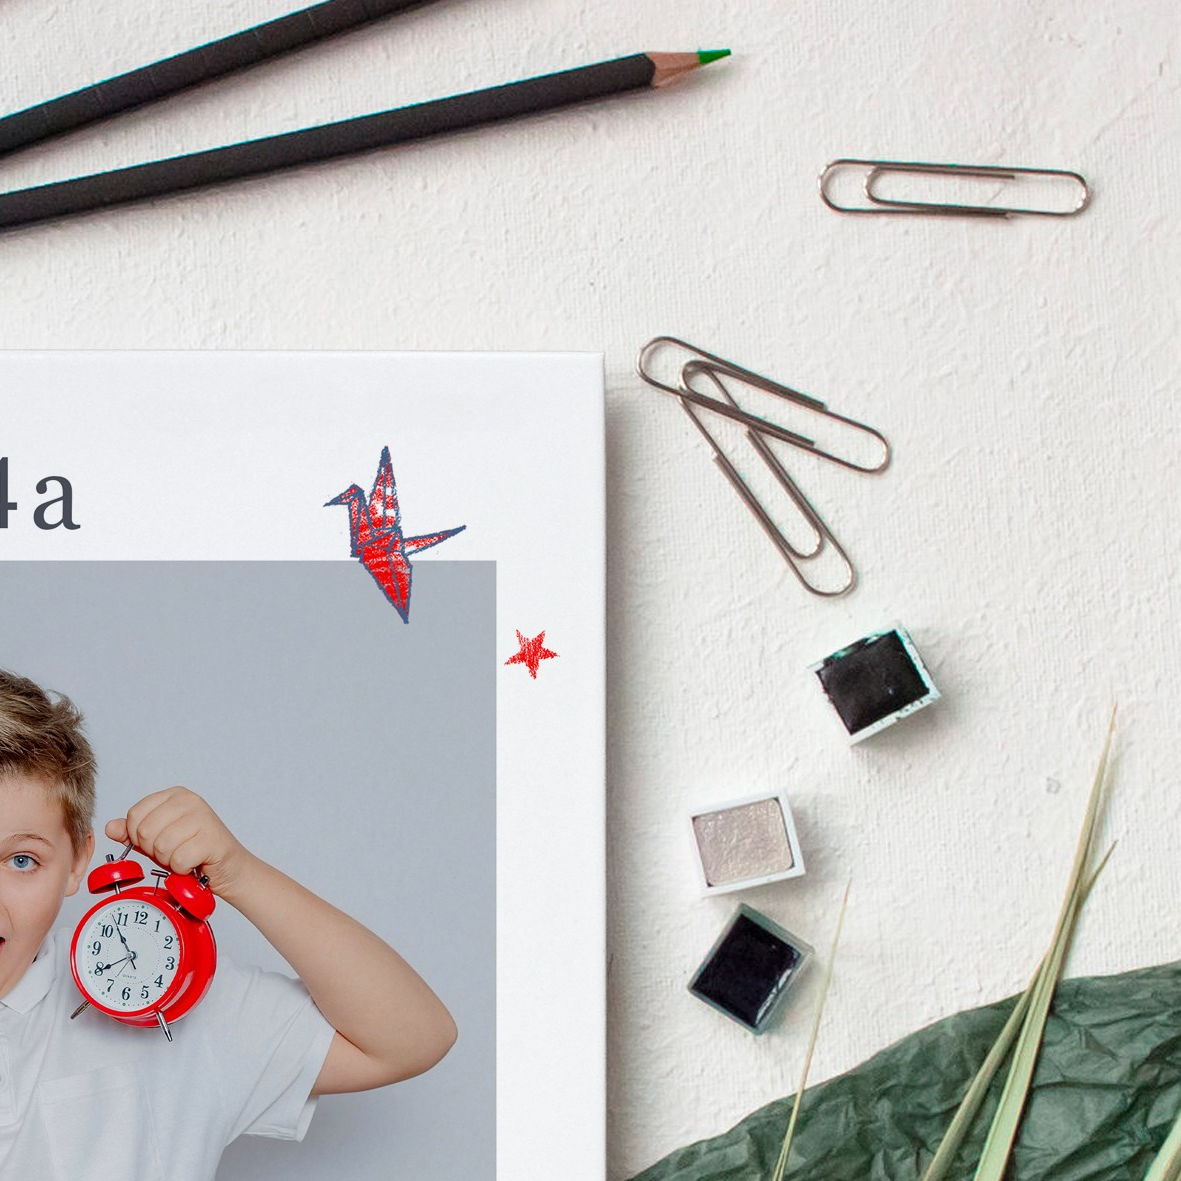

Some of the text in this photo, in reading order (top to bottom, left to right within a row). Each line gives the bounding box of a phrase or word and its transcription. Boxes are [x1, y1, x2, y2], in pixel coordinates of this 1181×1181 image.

[117, 912, 129, 927] 11
[133, 910, 149, 925] 12
[100, 924, 114, 938] 10
[154, 920, 161, 933] 1
[91, 940, 102, 956] 9
[163, 935, 174, 950] 2
[94, 961, 104, 977] 8
[165, 956, 175, 971] 3
[106, 978, 115, 993] 7
[153, 974, 164, 988] 4
[121, 986, 132, 1001] 6
[140, 985, 150, 999] 5
